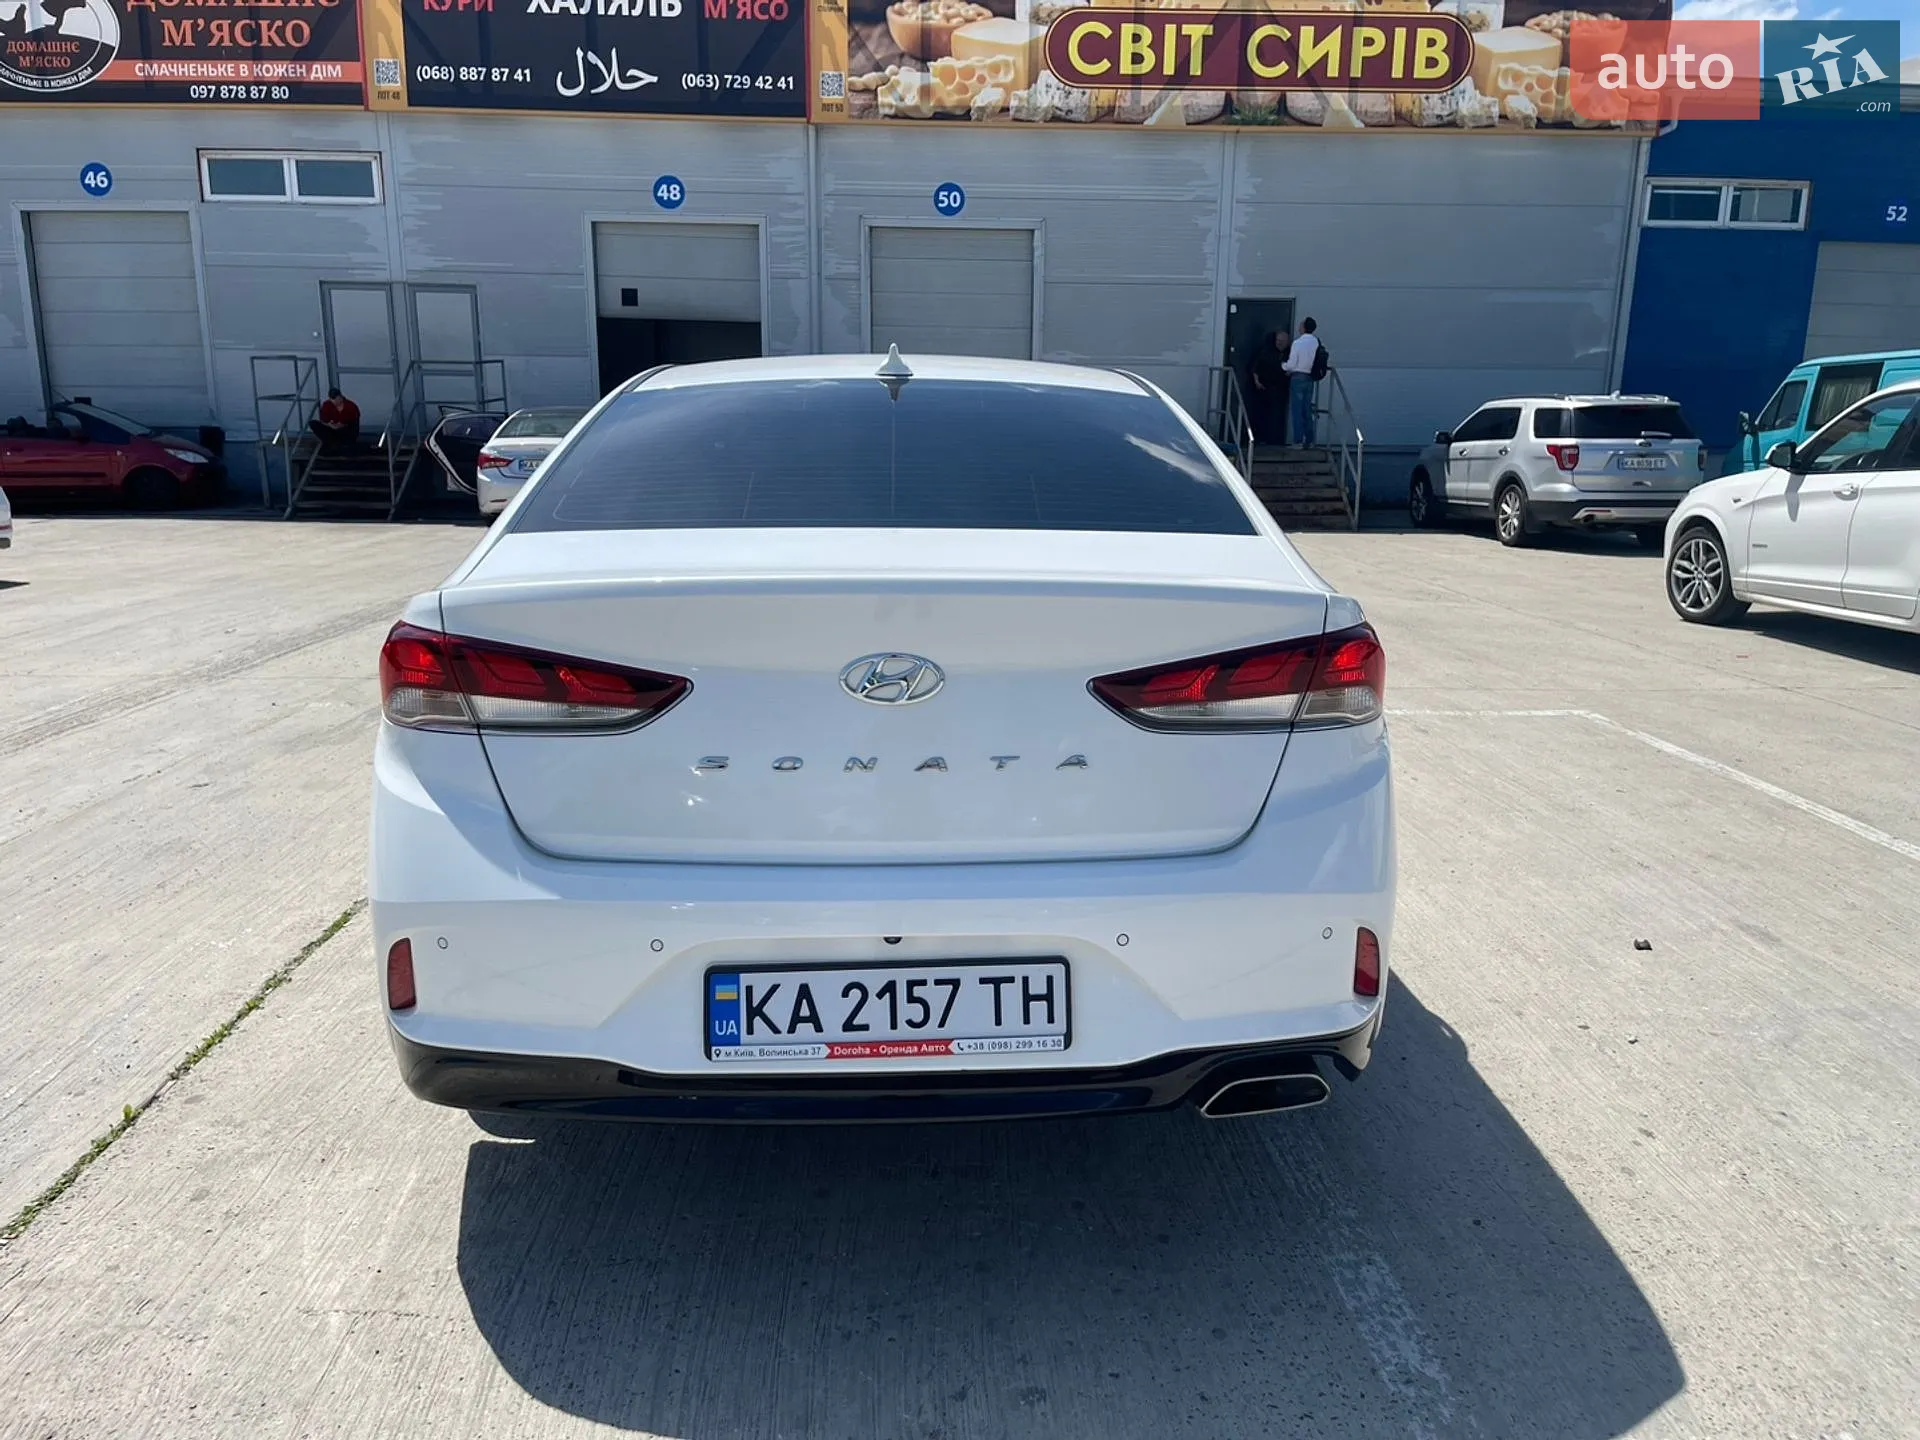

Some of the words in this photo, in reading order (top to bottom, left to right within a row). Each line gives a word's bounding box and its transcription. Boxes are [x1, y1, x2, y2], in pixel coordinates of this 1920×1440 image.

[6, 41, 81, 54] ДОМАШНЄ
[1067, 21, 1214, 77] СВІТ
[1245, 24, 1451, 79] СИРІВ
[134, 63, 236, 77] СМАЧНЕНЬКЕ
[239, 64, 249, 77] В
[253, 64, 306, 79] КОЖЕН
[310, 65, 343, 81] ДІМ
[415, 65, 456, 82] (068)
[459, 67, 487, 82] 887
[491, 68, 510, 83] 87
[513, 68, 532, 83] 41
[555, 46, 659, 98] حلال
[681, 73, 720, 90] (063)
[723, 74, 751, 89] 729
[754, 75, 774, 90] 42
[777, 76, 795, 90] 41
[190, 85, 218, 99] 097
[220, 86, 247, 100] 878
[250, 86, 269, 100] 87
[272, 86, 290, 100] 80
[84, 171, 109, 188] 46
[656, 184, 682, 201] 48
[937, 190, 961, 208] 50
[1886, 205, 1907, 221] 52
[697, 755, 1090, 773] SONATA
[745, 984, 824, 1036] KA
[840, 978, 961, 1032] 2157
[978, 974, 1056, 1027] TH
[714, 1020, 739, 1036] UA
[811, 1047, 822, 1056] 37
[834, 1046, 871, 1055] Doroha
[879, 1044, 918, 1055] Оренда
[920, 1043, 946, 1053] Авто
[967, 1041, 984, 1051] +38
[987, 1040, 1013, 1051] (098)
[1015, 1039, 1033, 1049] 299
[1037, 1038, 1048, 1048] 16
[1050, 1038, 1062, 1047] 30
